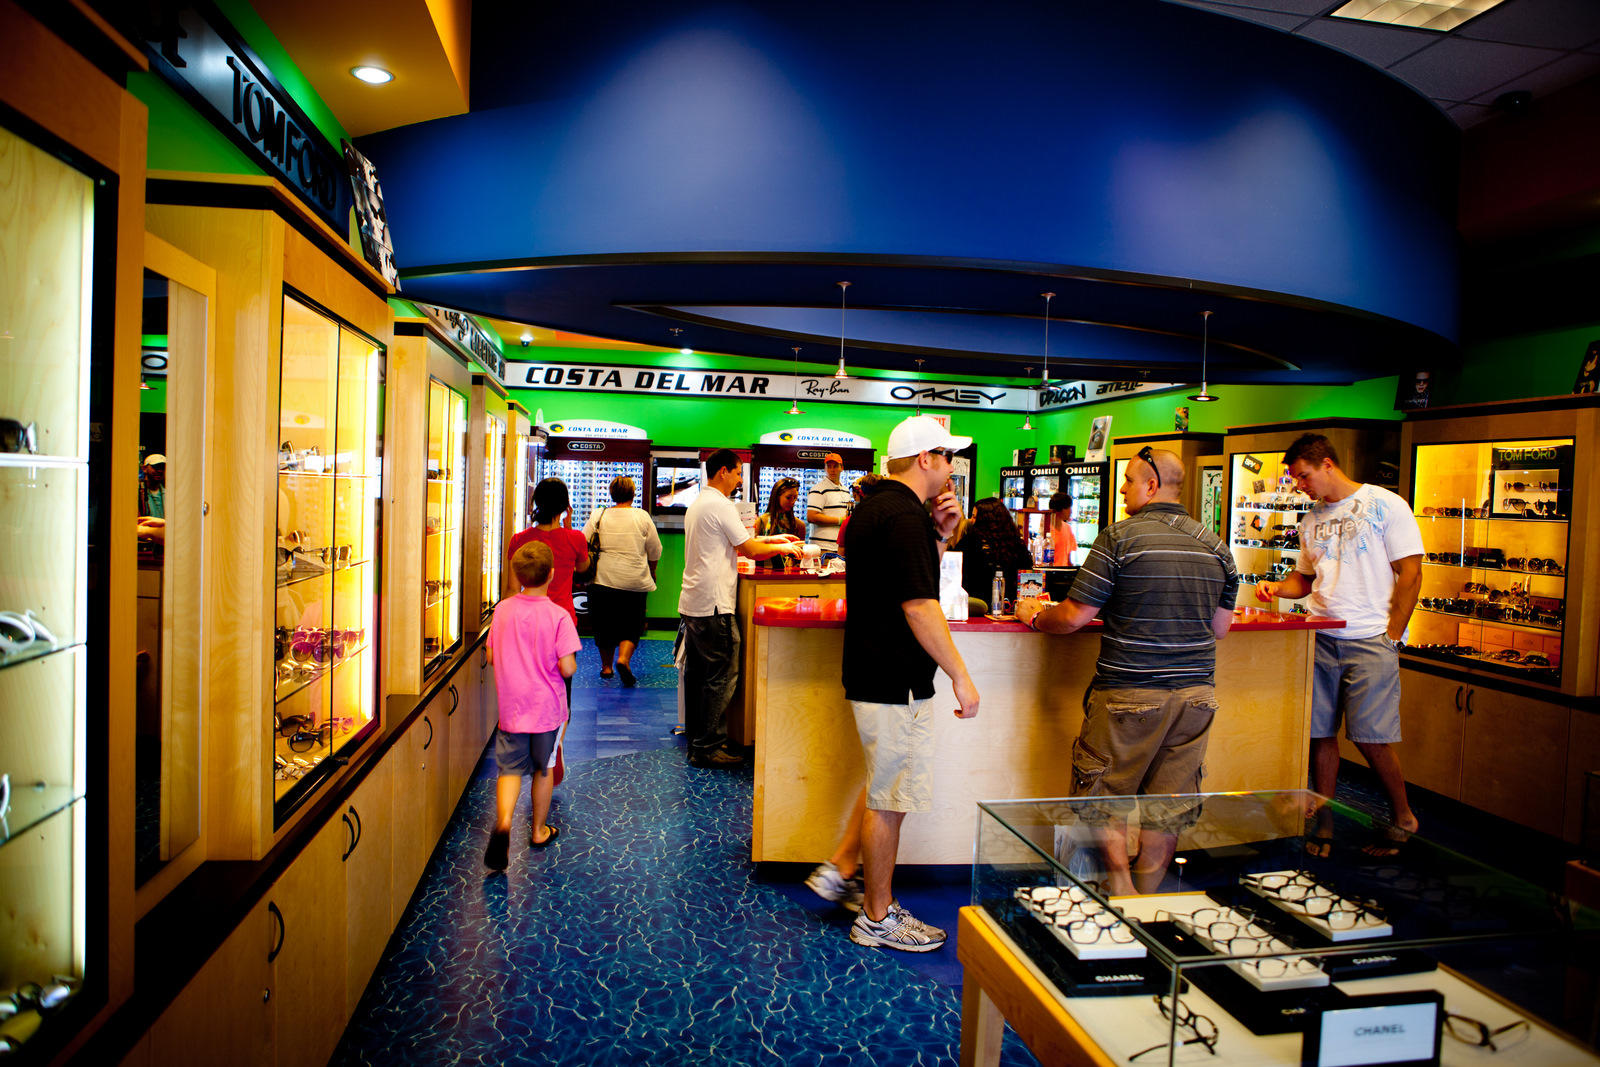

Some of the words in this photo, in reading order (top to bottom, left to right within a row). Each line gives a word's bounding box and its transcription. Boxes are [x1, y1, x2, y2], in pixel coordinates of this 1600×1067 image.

[525, 366, 623, 388] COSTA
[634, 371, 690, 391] DEL
[701, 374, 770, 395] MAR
[801, 380, 850, 398] Ray-Ban
[890, 386, 1007, 405] OAKLEY
[1040, 383, 1087, 408] DRAGON
[1498, 448, 1523, 462] TOM
[1524, 447, 1557, 461] FORD
[1074, 466, 1100, 474] OAKLEY
[1353, 1023, 1406, 1037] CHANEL
